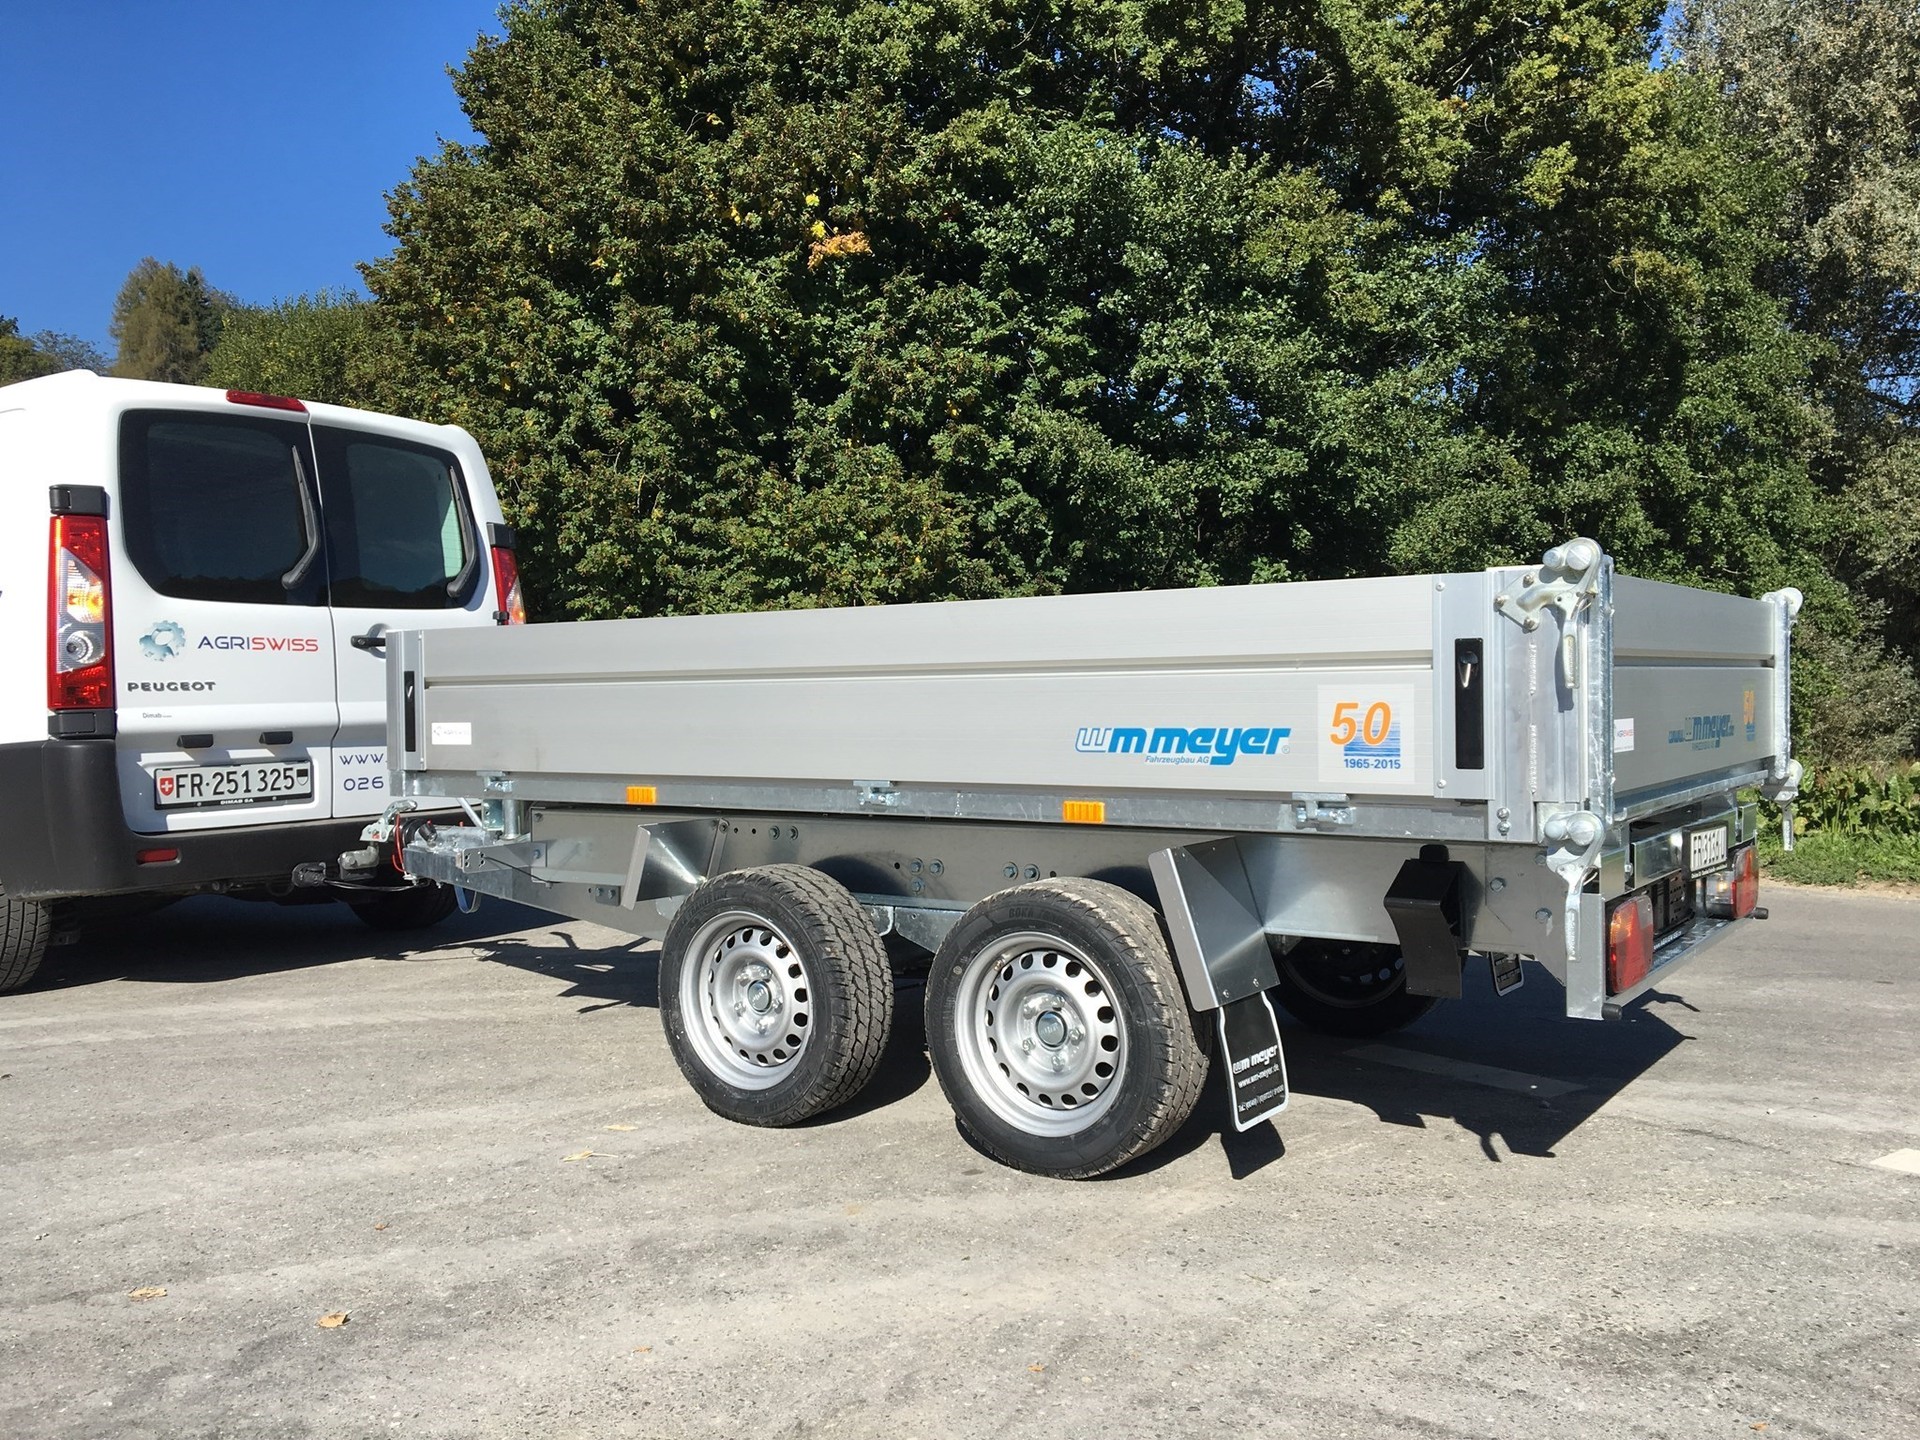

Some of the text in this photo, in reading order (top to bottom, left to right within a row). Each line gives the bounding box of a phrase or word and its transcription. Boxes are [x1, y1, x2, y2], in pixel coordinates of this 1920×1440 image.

[197, 635, 319, 652] AGRISWISS
[127, 681, 216, 692] PEUGEOT
[1329, 701, 1392, 745] 50
[1145, 755, 1210, 765] Fahrzeugbau AG
[1343, 758, 1401, 769] 1965-2015
[343, 776, 384, 791] 026
